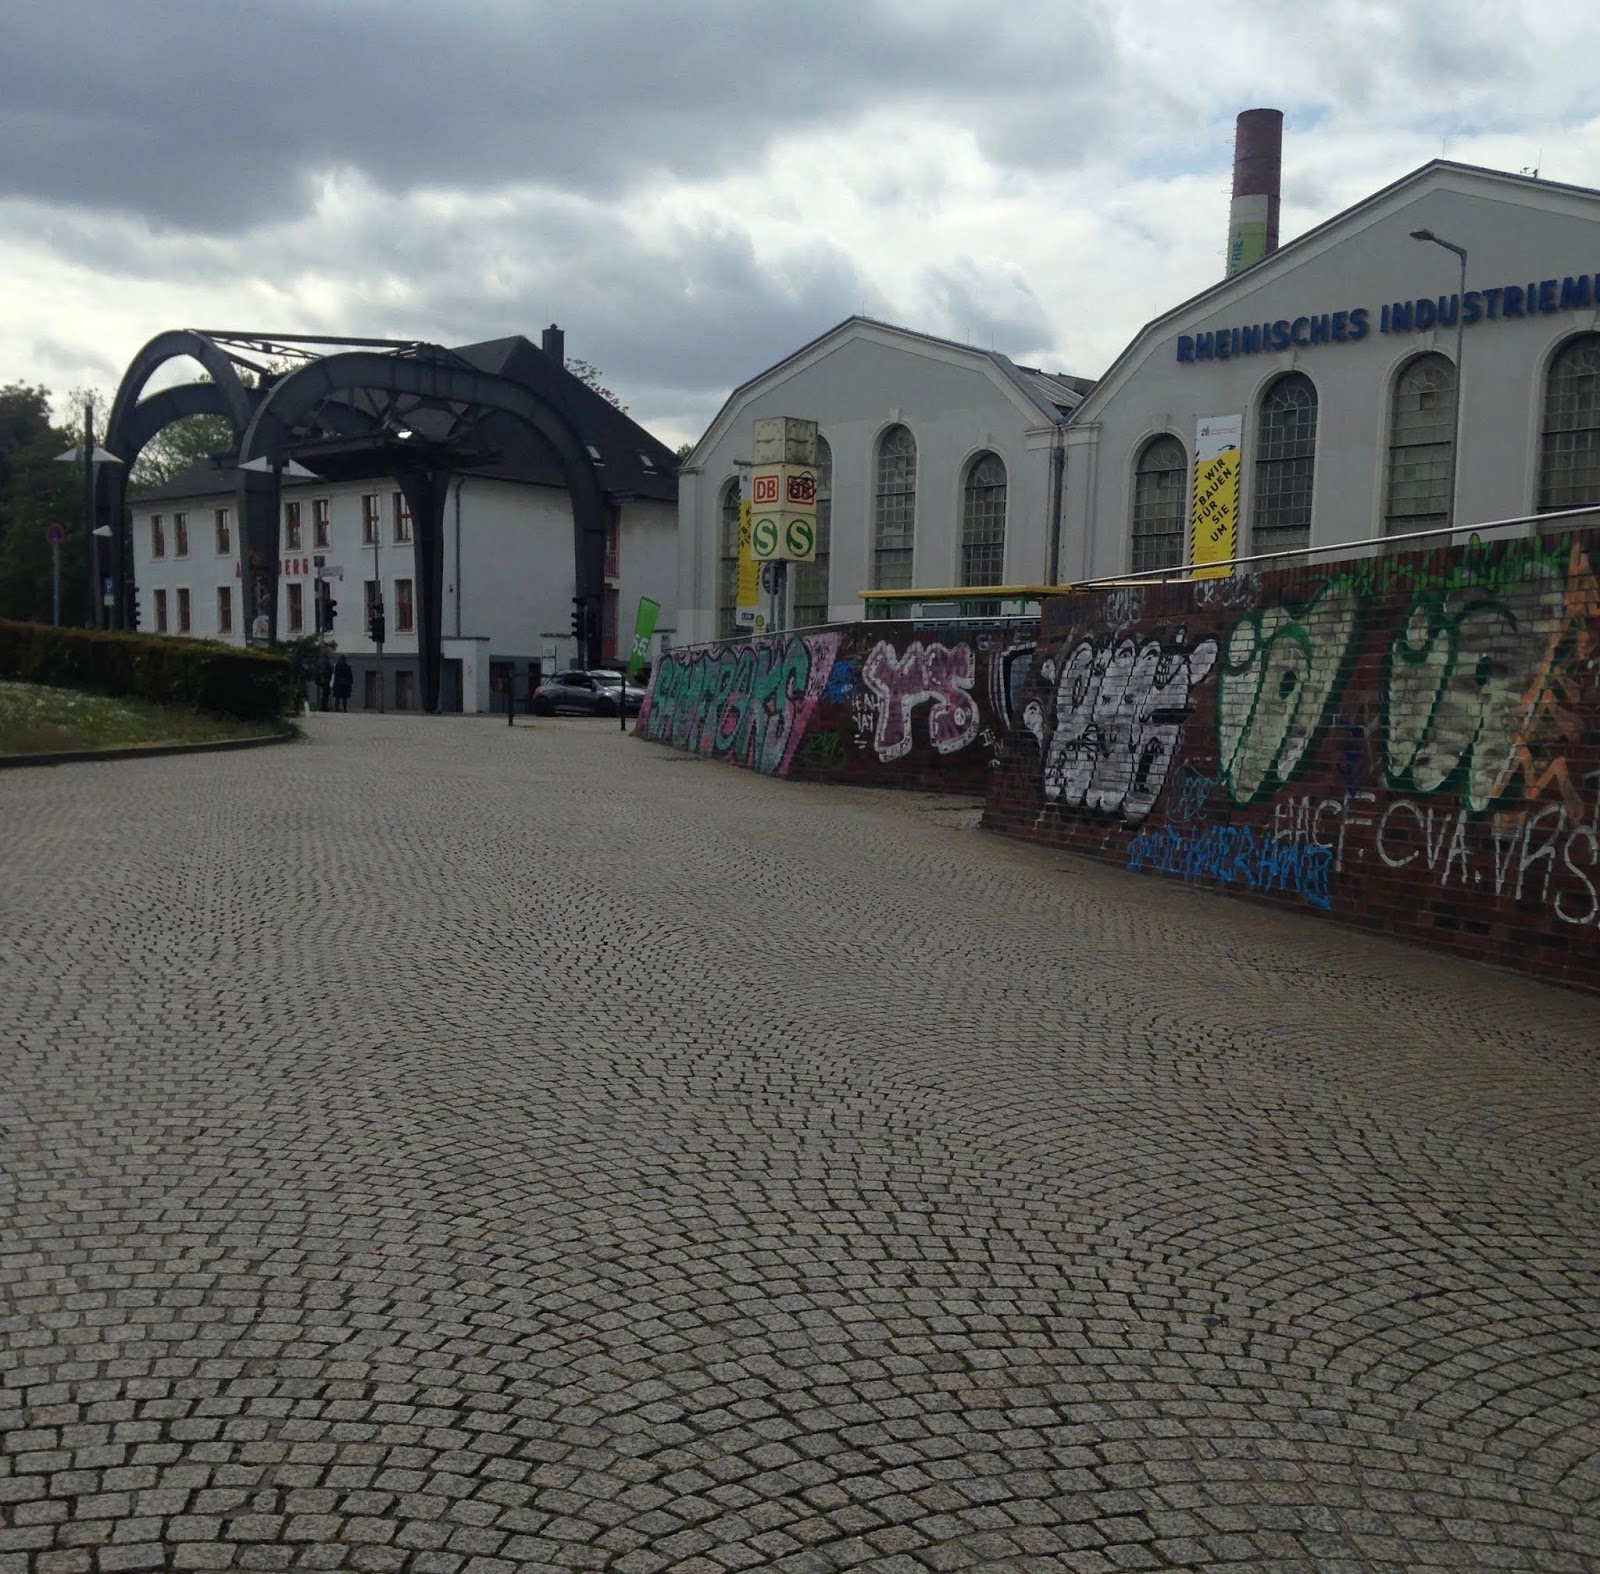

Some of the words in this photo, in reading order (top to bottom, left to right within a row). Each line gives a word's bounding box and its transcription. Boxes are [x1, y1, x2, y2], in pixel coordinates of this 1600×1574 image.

[1177, 308, 1371, 363] RHEINISCHES
[1380, 273, 1600, 333] INDUSTRIEM
[1204, 459, 1226, 480] WIR
[756, 480, 776, 500] DB
[1198, 468, 1232, 505] BAUEN
[1197, 501, 1218, 524] FÜR
[1212, 504, 1230, 524] SIE
[754, 520, 777, 555] S
[787, 520, 813, 556] S
[1210, 523, 1227, 542] UM
